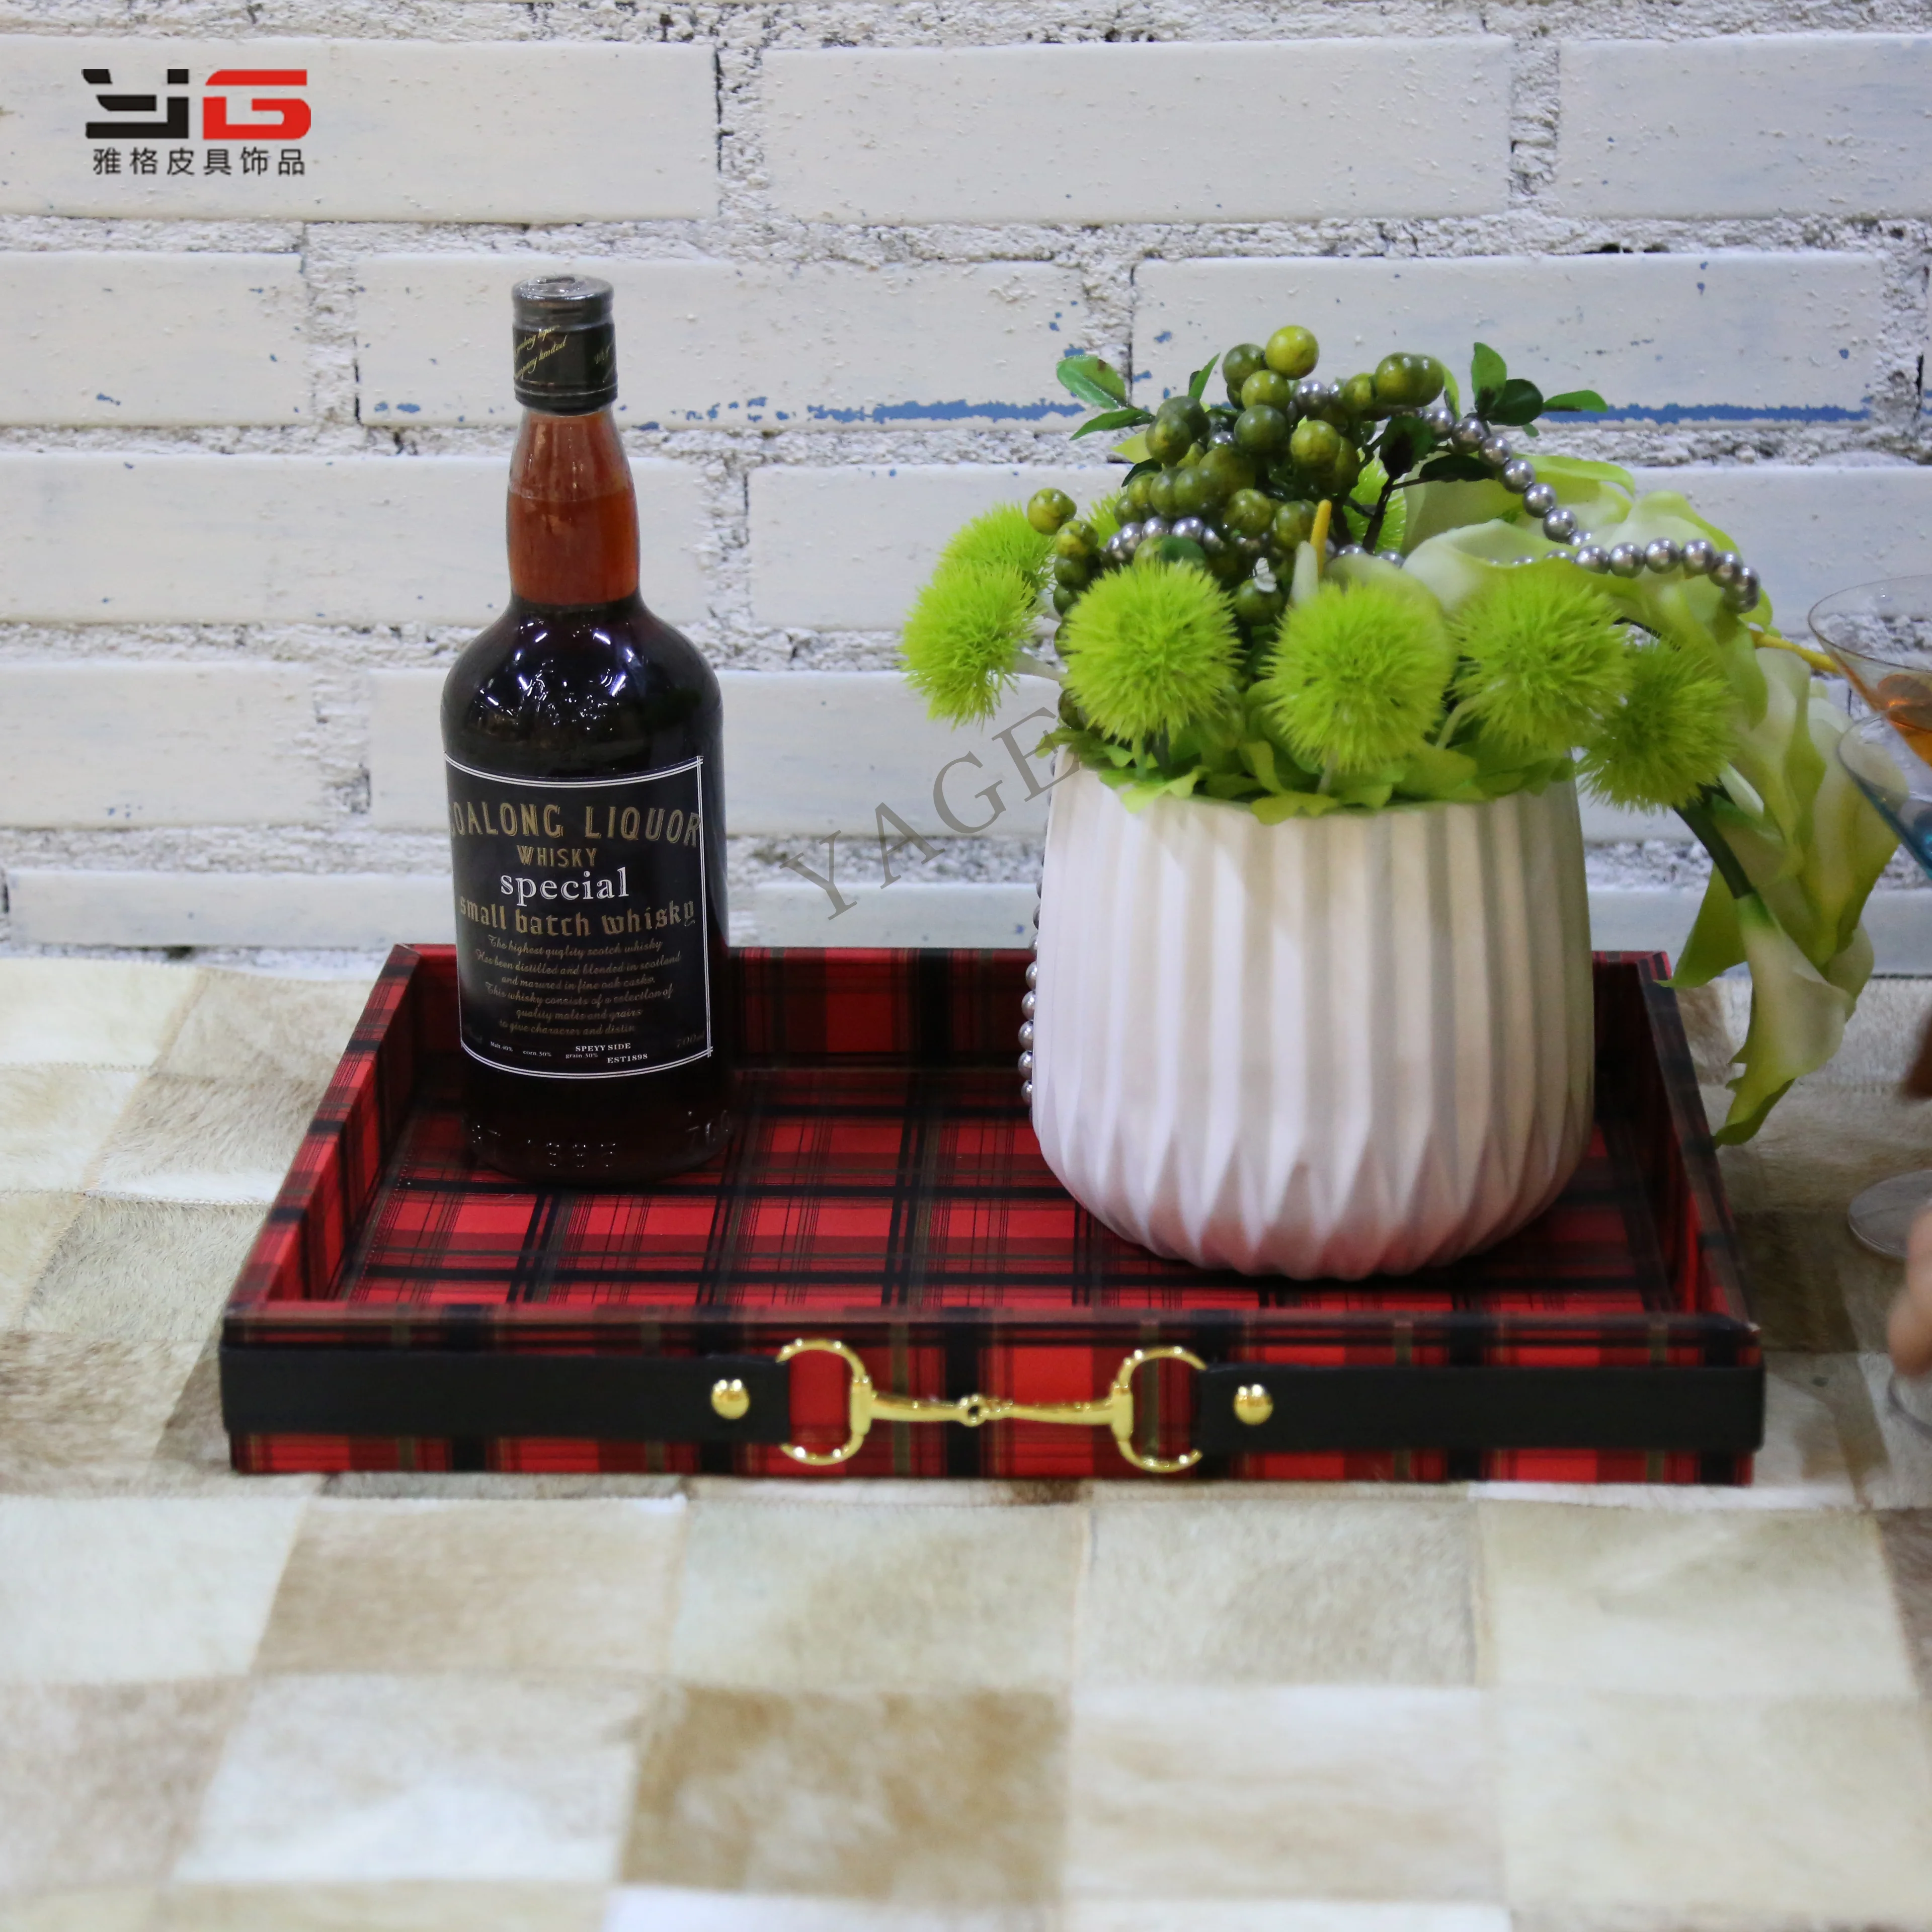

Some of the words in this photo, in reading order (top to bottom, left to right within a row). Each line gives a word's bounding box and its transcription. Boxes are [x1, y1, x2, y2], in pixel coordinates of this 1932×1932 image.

[585, 806, 700, 847] LIQUOR
[517, 845, 598, 867] WHISKY
[500, 867, 629, 907] special
[460, 896, 507, 930] small
[515, 909, 591, 936] batch
[601, 900, 695, 935] whisky
[488, 934, 507, 949] The
[508, 940, 543, 956] highest
[587, 943, 621, 956] scotch
[624, 937, 663, 951] whisky
[495, 955, 513, 969] been
[515, 960, 557, 974] distilled
[560, 964, 580, 975] and
[583, 961, 624, 975] blended
[626, 962, 637, 972] in
[640, 951, 682, 968] scotland
[485, 981, 506, 997] This
[507, 989, 543, 1007] whisky
[545, 995, 589, 1005] consists
[591, 993, 603, 1008] of
[662, 983, 674, 999] of
[502, 976, 518, 986] and
[564, 980, 577, 990] in
[578, 978, 601, 994] fine
[601, 977, 621, 989] oak
[587, 1009, 607, 1020] and
[499, 1019, 509, 1028] to
[510, 1022, 528, 1033] give
[582, 1024, 603, 1035] and
[607, 1042, 631, 1051] SIDE
[607, 1053, 649, 1064] EST1898
